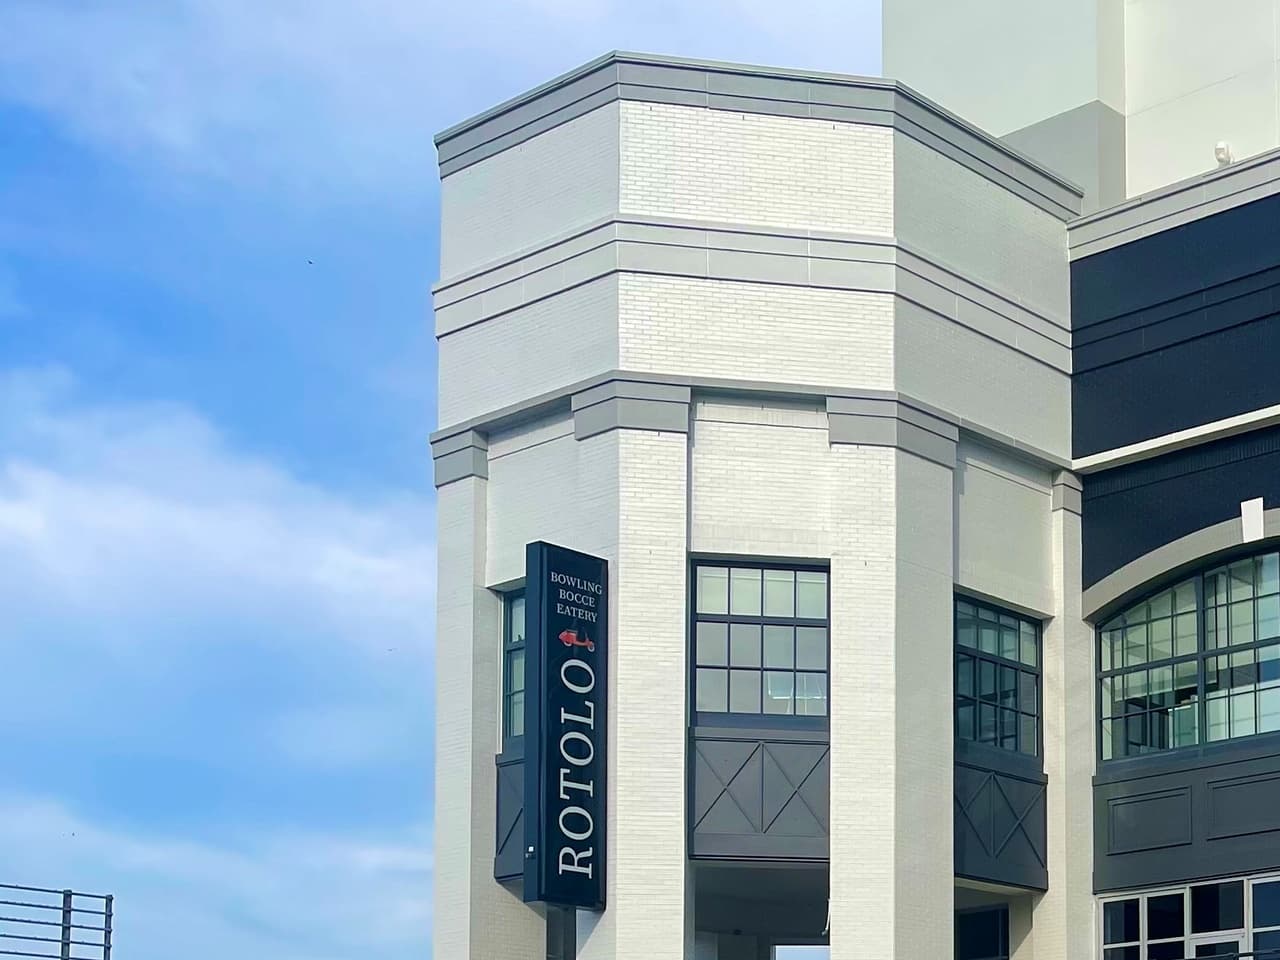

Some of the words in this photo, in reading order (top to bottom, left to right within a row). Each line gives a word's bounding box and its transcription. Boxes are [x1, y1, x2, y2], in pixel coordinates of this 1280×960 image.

[551, 571, 602, 595] BOWLING
[559, 588, 595, 608] BOCCE
[557, 603, 597, 623] EATERY
[558, 658, 596, 880] ROTOLO
